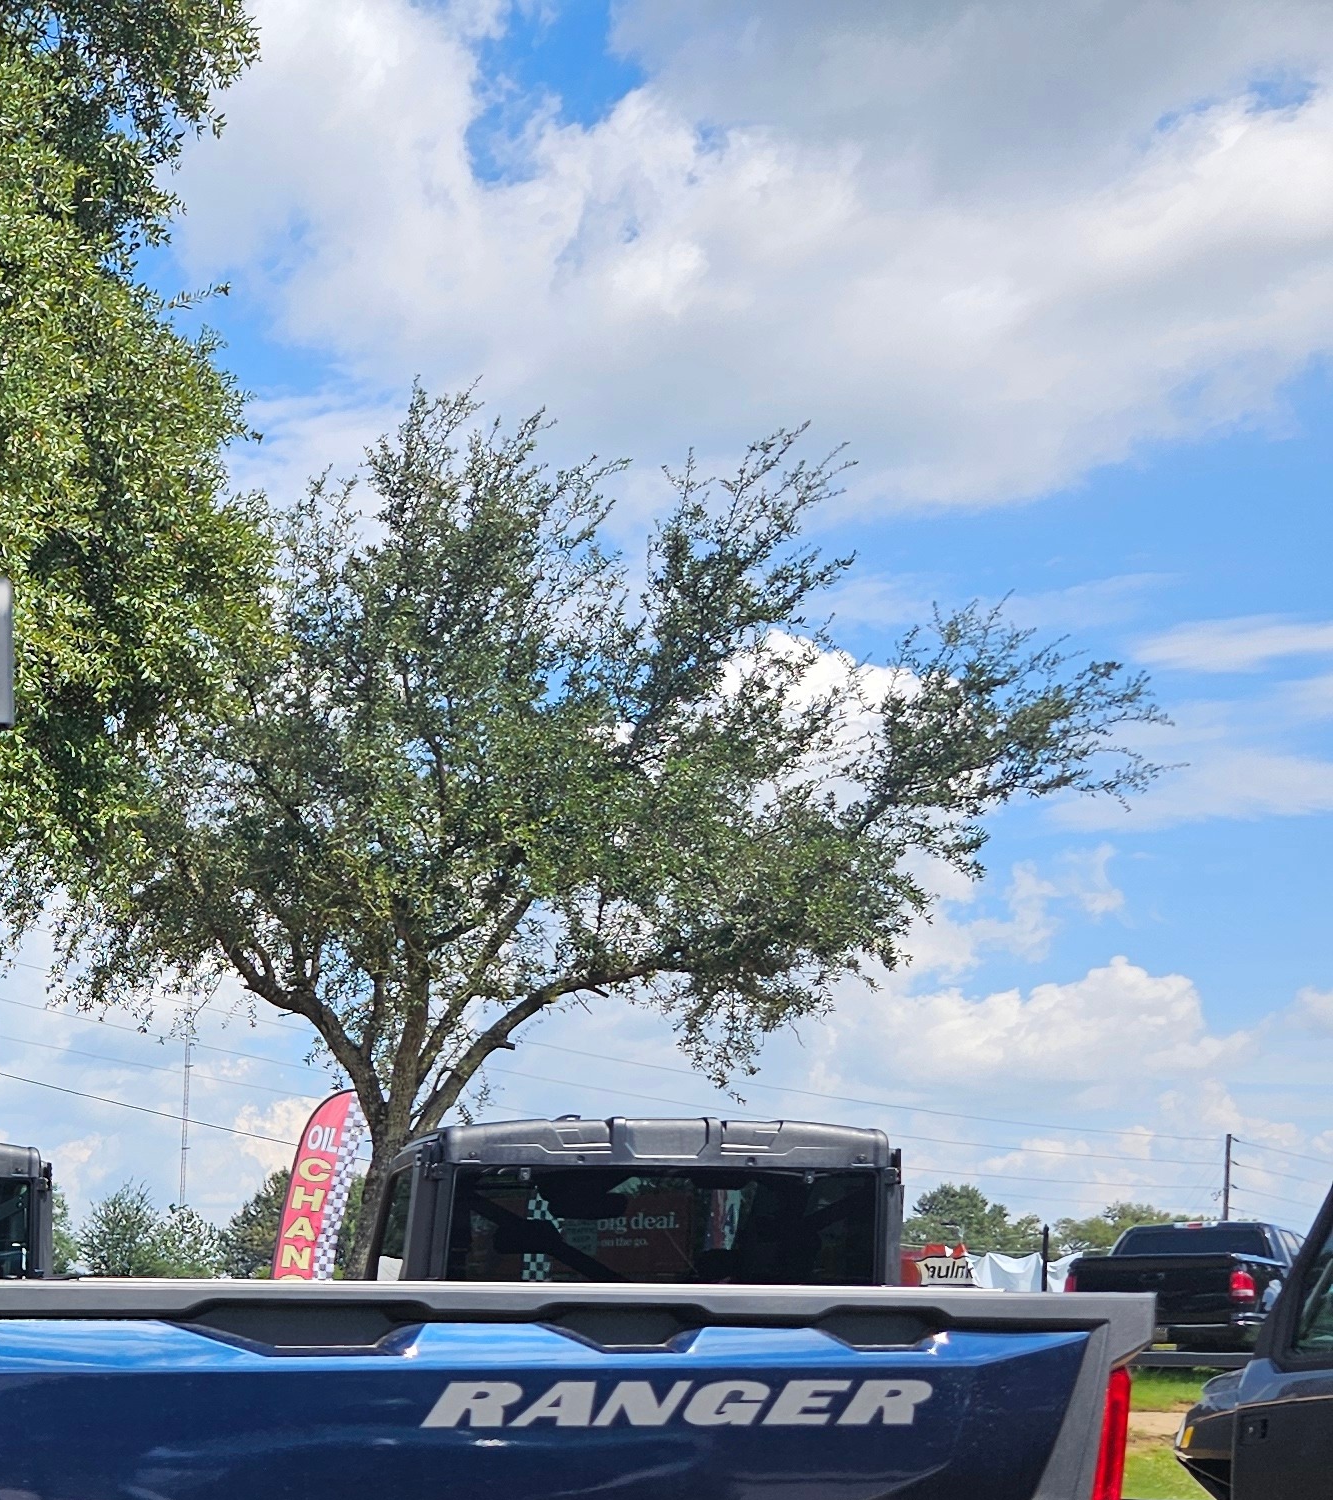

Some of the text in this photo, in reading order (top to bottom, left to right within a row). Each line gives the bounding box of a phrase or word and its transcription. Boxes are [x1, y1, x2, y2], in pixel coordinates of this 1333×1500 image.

[307, 1124, 339, 1153] OIL
[279, 1156, 333, 1280] CHAN
[419, 1379, 934, 1428] RANGER
